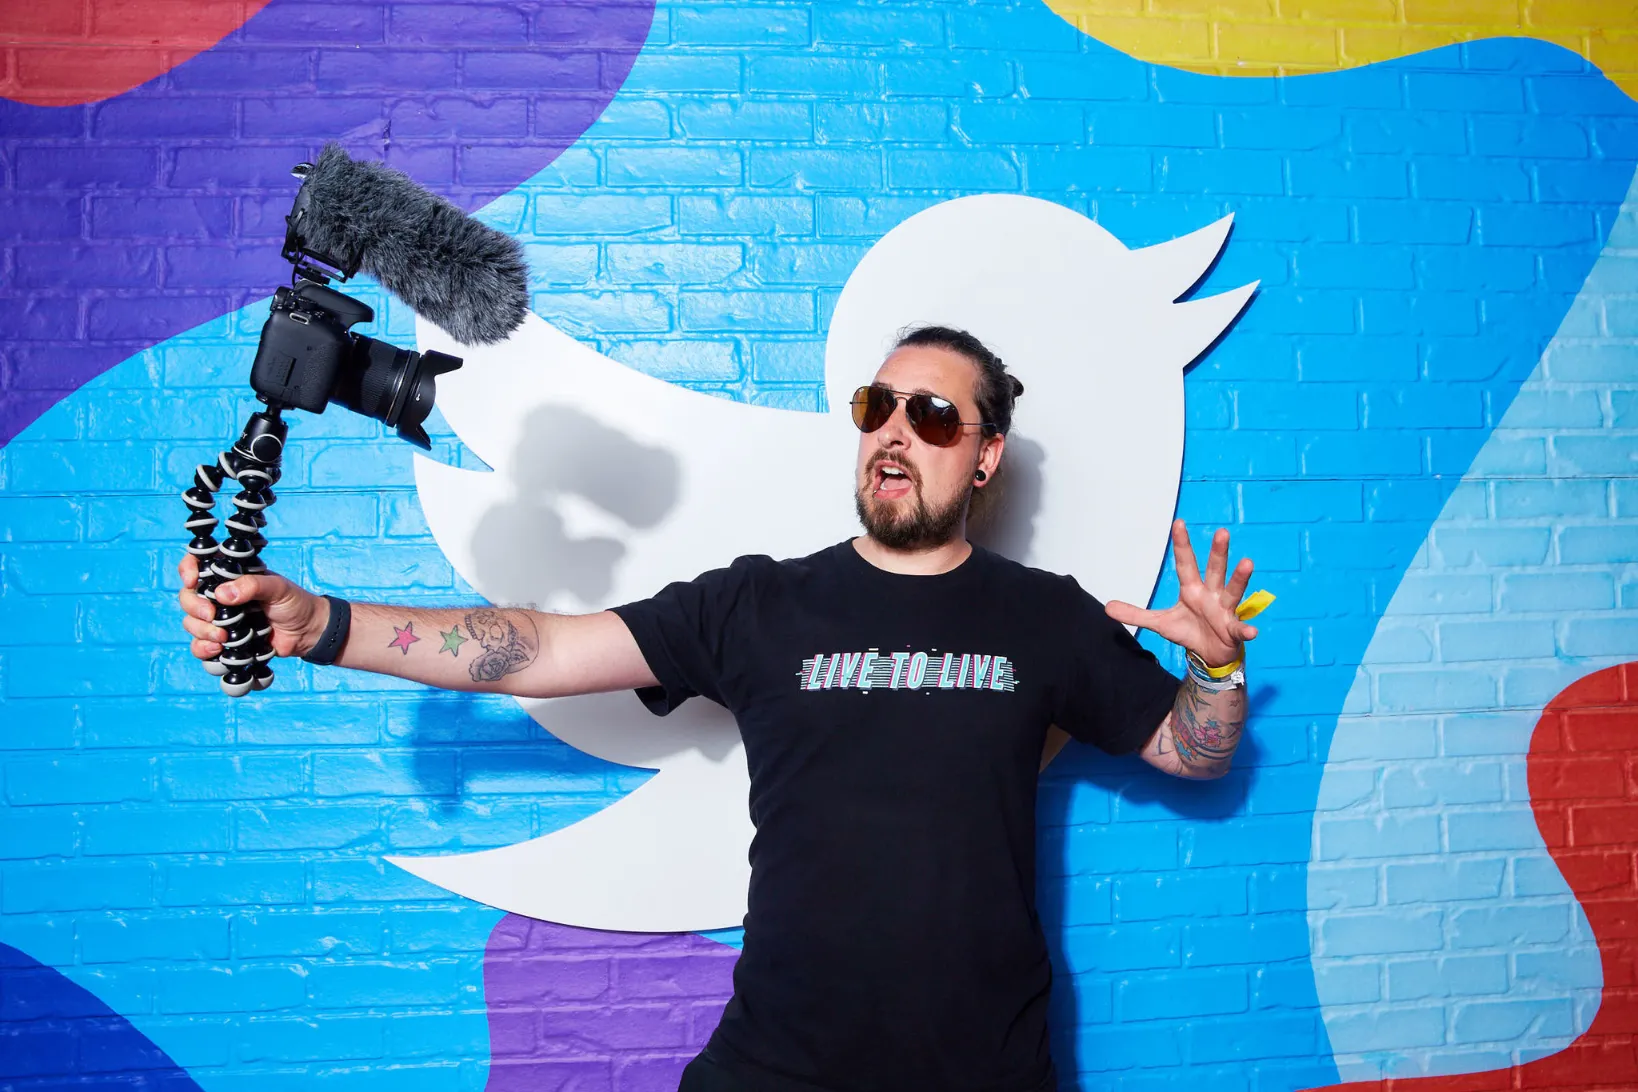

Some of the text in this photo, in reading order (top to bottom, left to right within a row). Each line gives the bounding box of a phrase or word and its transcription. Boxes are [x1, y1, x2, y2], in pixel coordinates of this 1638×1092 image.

[806, 651, 1008, 691] LIVE TO LIVE
